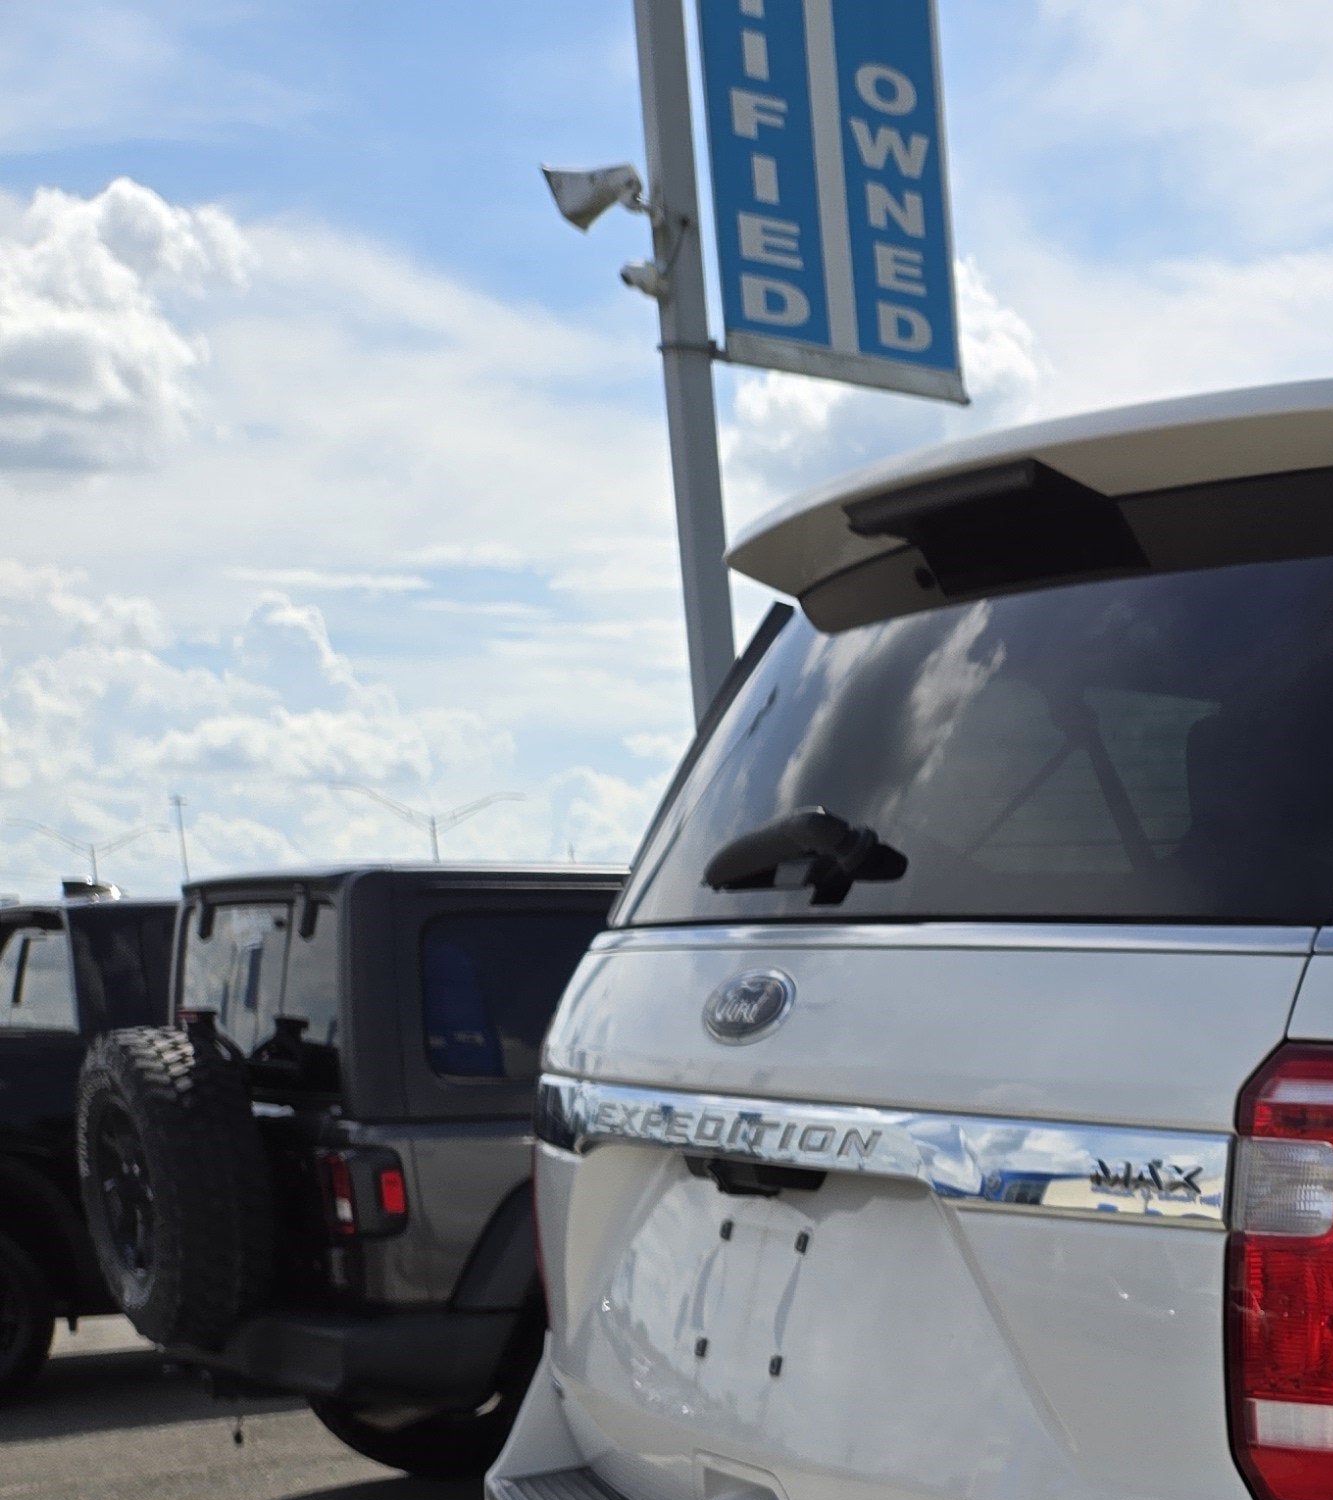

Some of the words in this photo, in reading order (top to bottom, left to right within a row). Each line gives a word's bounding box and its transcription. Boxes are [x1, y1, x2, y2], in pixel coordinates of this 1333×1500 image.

[850, 62, 933, 353] OWNED
[594, 1101, 883, 1159] EXPEDITION
[1089, 1158, 1203, 1197] MAX
